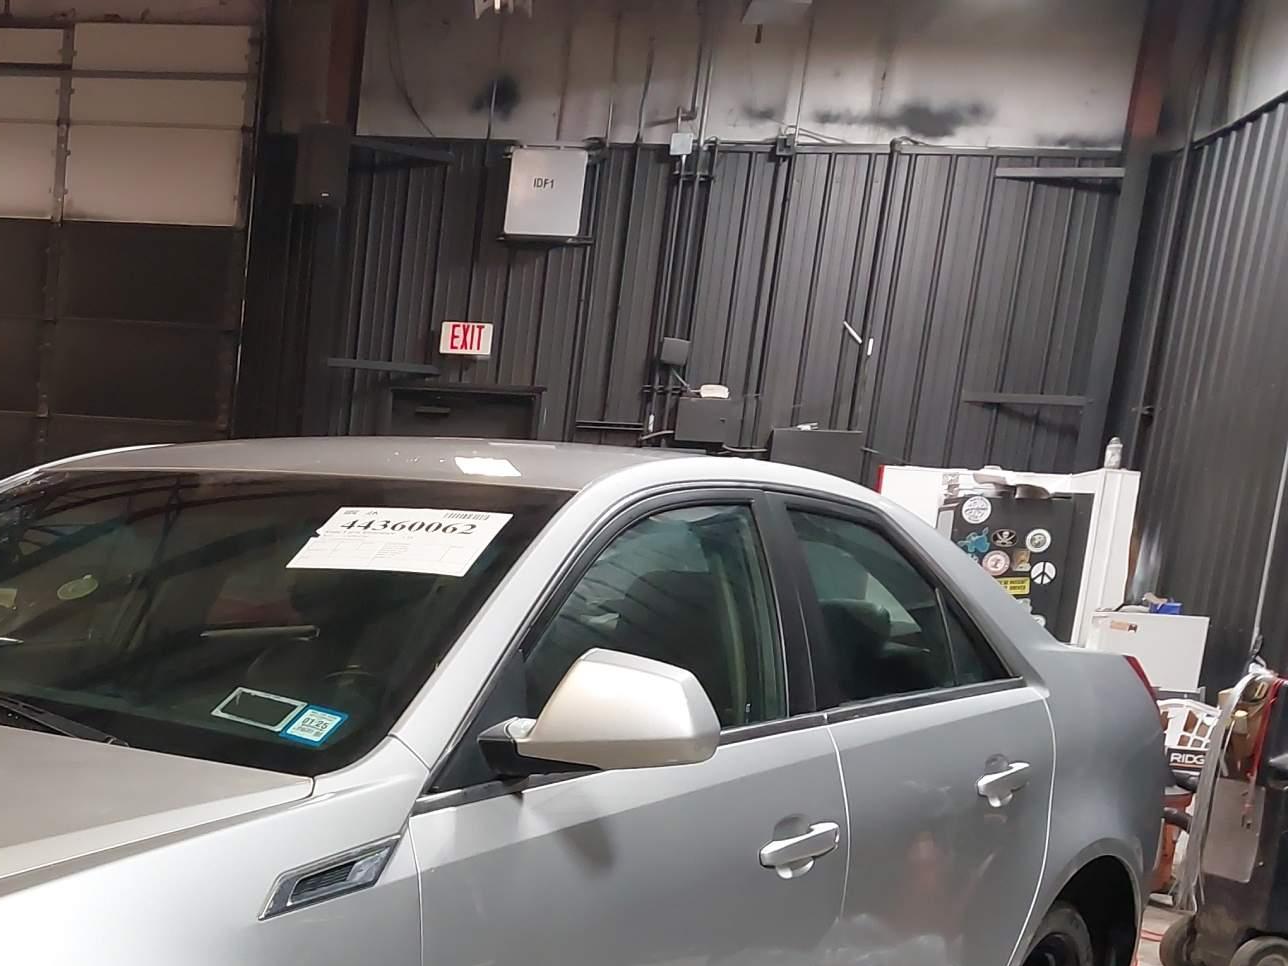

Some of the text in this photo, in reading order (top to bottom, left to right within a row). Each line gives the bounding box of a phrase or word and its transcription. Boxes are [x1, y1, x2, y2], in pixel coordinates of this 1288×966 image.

[533, 177, 554, 189] IDF1
[450, 324, 485, 350] EXIT
[340, 518, 477, 535] 44360062
